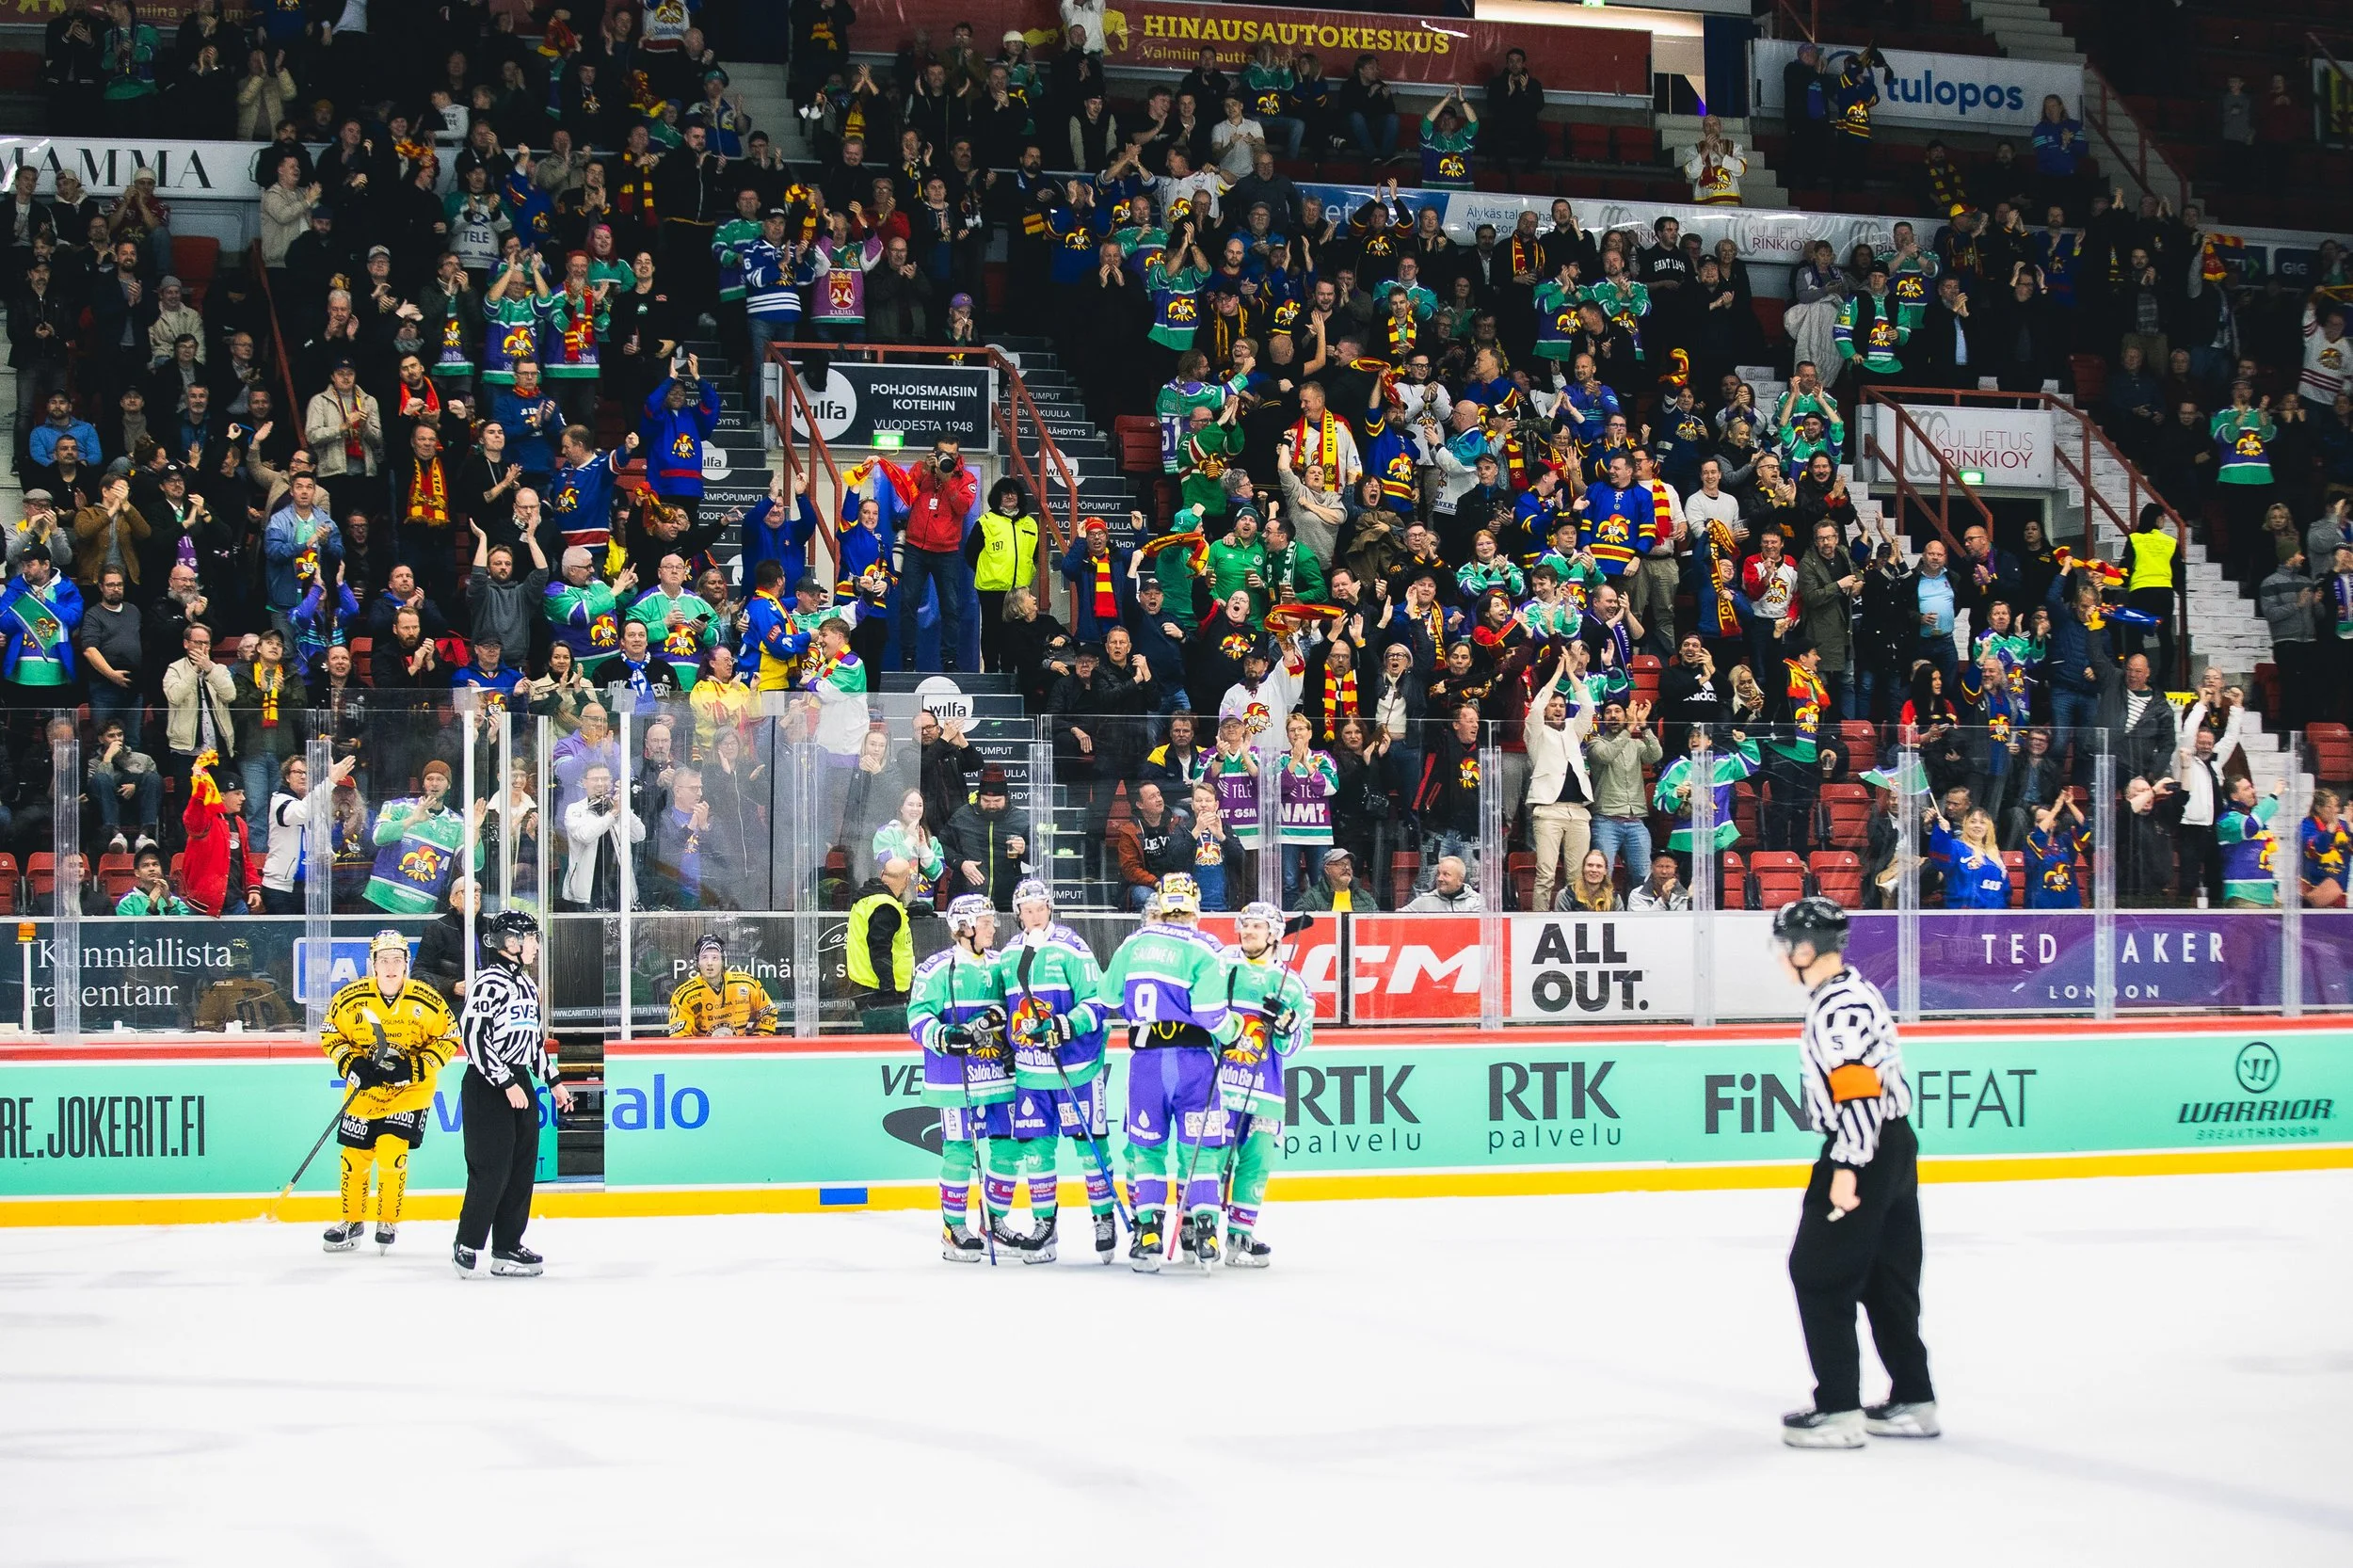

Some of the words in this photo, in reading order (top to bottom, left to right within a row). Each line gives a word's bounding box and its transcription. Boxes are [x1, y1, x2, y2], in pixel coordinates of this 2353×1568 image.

[1144, 15, 1450, 54] HINAUSAUTOKESKUS
[1886, 70, 2024, 115] tulopos
[1466, 204, 1501, 220] Älykäs
[463, 231, 489, 245] TELE
[871, 382, 978, 397] POHJOISMAISIIN
[892, 399, 955, 411] KOTEIHIN
[873, 419, 942, 431] VUODESTA
[946, 421, 973, 432] 1948
[1935, 428, 2033, 451] KULJETUS
[991, 541, 1004, 552] 197
[930, 702, 966, 717] wilfa
[1234, 808, 1257, 818] GSM
[1280, 803, 1326, 824] NMT
[38, 937, 233, 969] Kunniallista
[1532, 923, 1627, 965] ALL
[1981, 934, 2057, 965] TED
[1532, 970, 1649, 1013] OUT.
[472, 1000, 490, 1014] 40
[1132, 983, 1159, 1047] 9
[1832, 1036, 1844, 1051] 5
[1285, 1064, 1421, 1127] RTK
[1488, 1061, 1622, 1121] RTK
[2177, 1098, 2334, 1125] WARRIOR
[342, 1118, 368, 1136] WOOD
[2196, 1127, 2320, 1142] BREAKTHROUGH
[1284, 1128, 1422, 1160] palvelu
[1489, 1123, 1622, 1154] palvelu
